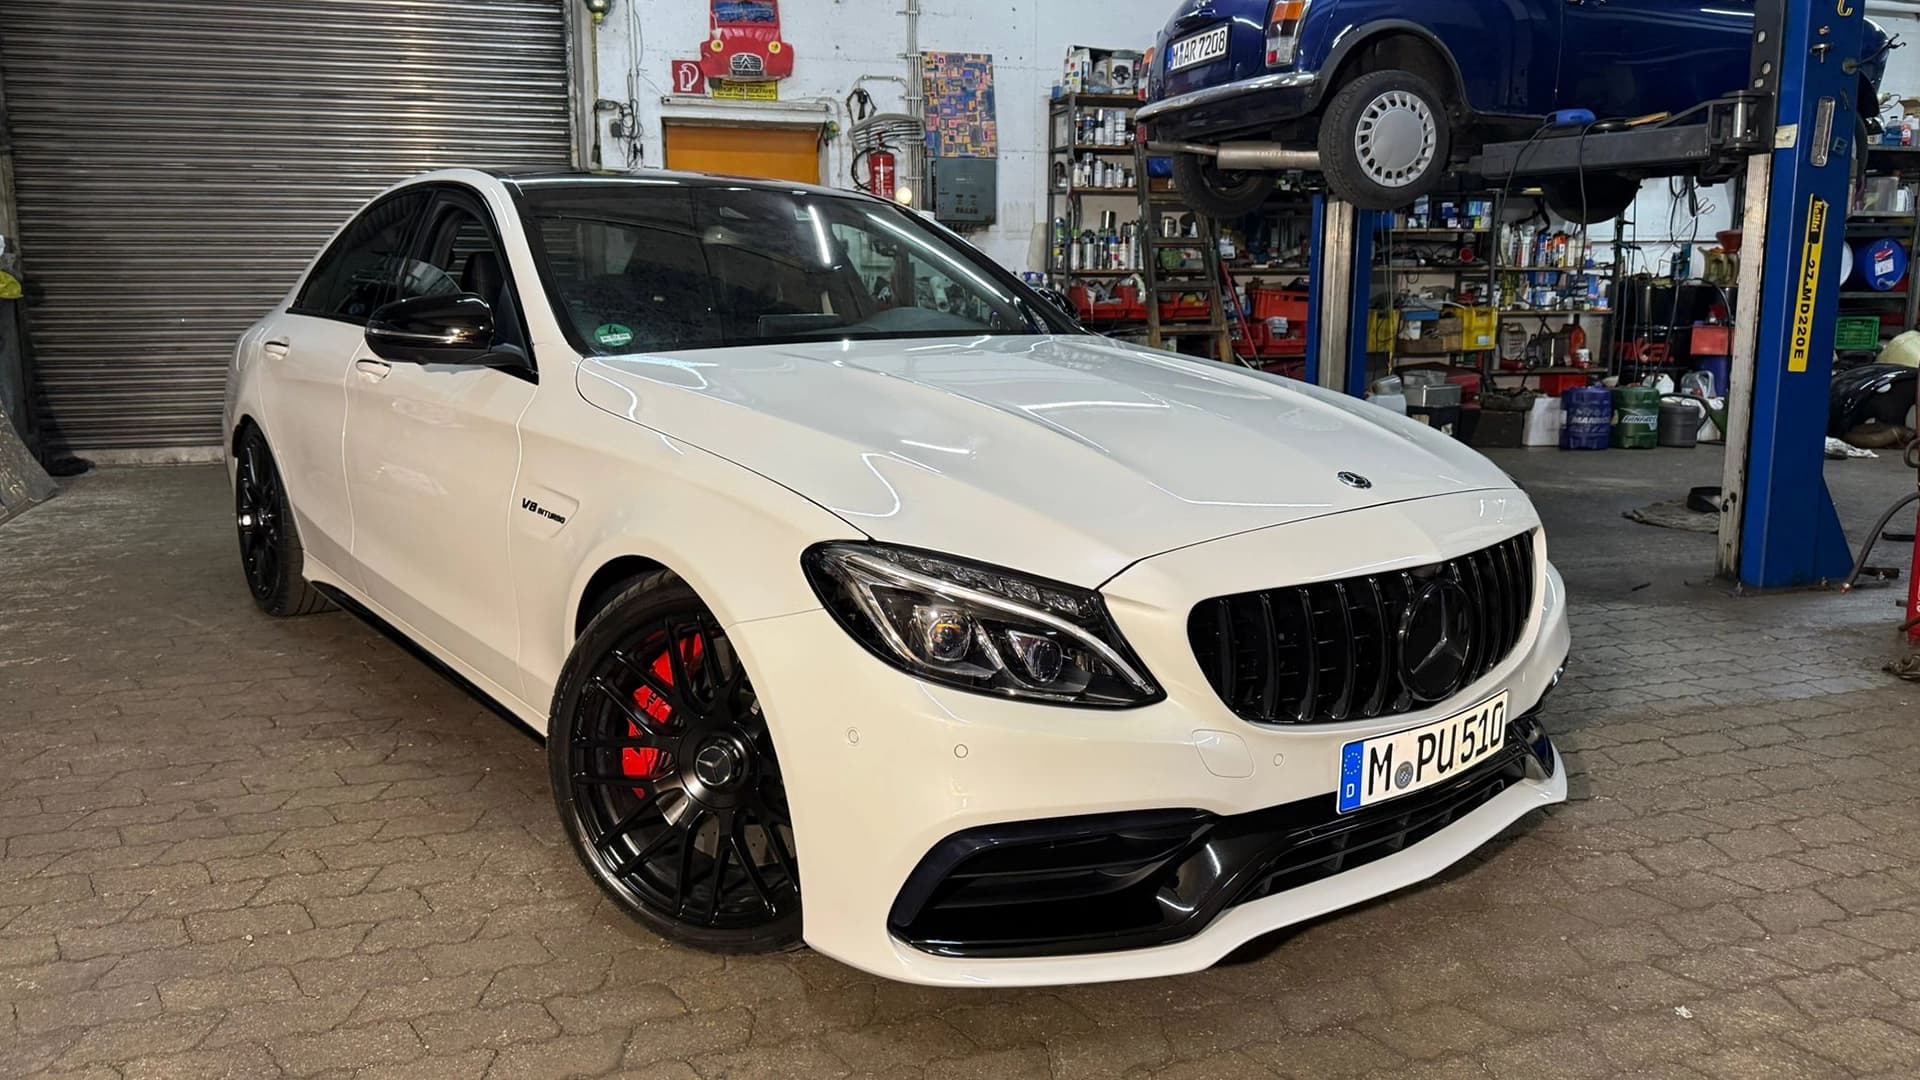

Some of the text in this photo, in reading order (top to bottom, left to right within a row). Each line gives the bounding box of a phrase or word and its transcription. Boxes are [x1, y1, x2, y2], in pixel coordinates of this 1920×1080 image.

[1184, 40, 1196, 63] AR
[1199, 30, 1226, 59] 7208
[522, 498, 538, 512] V8
[1368, 701, 1504, 796] M PU 510
[1346, 783, 1355, 798] D
